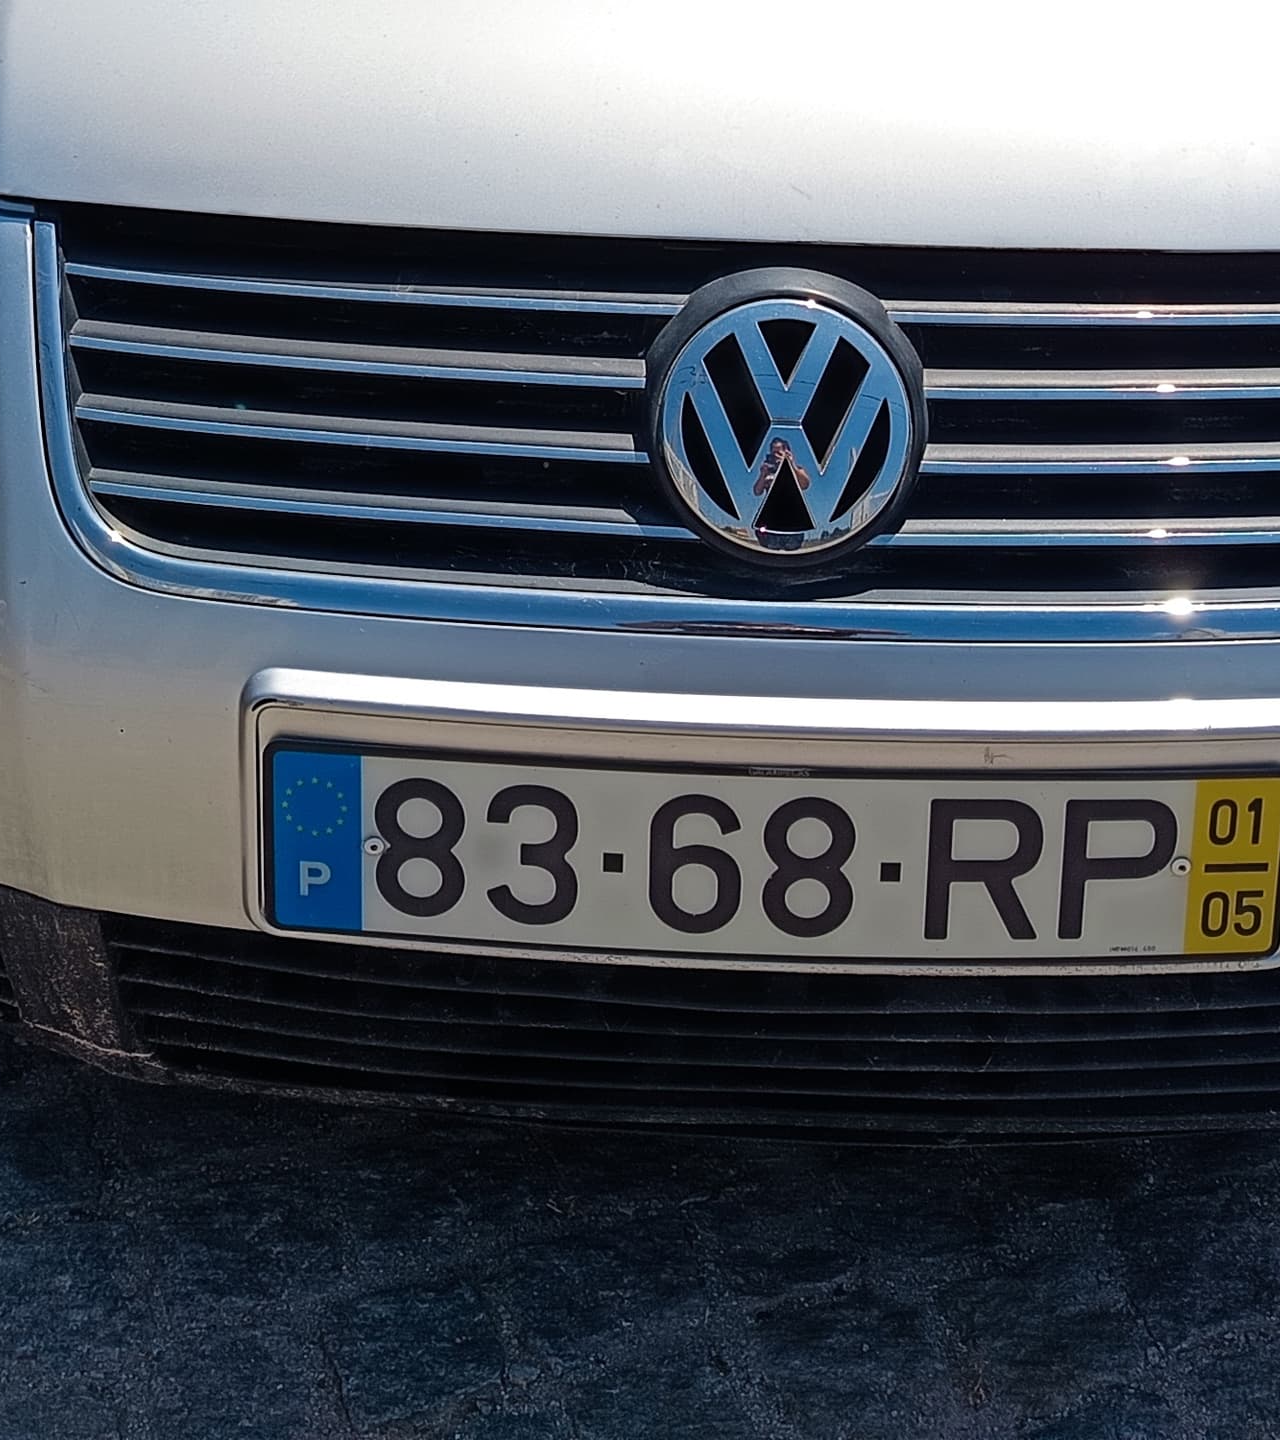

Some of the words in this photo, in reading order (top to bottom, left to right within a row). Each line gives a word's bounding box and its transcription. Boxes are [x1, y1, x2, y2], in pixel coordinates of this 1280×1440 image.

[1209, 798, 1263, 845] 01
[300, 861, 331, 896] P
[1201, 890, 1264, 937] 05
